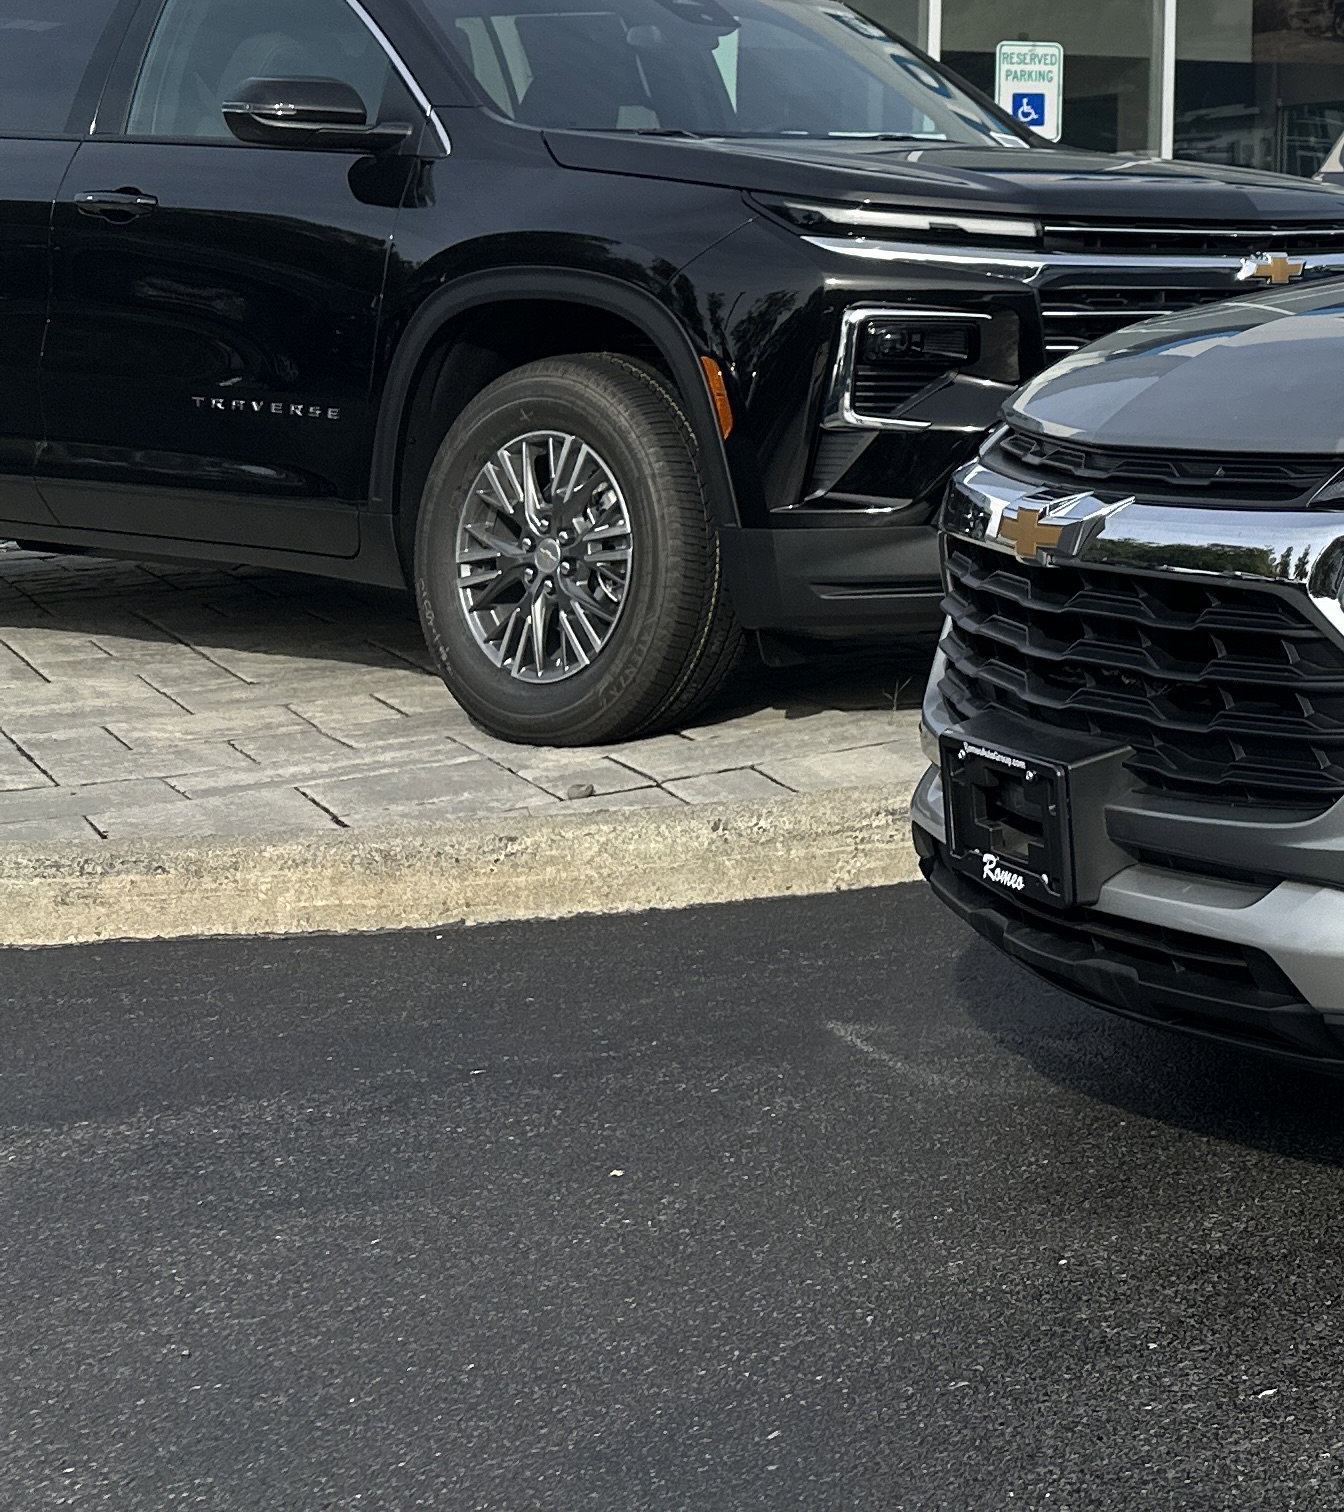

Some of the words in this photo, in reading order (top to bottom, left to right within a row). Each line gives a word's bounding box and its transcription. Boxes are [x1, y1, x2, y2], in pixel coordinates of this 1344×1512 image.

[1001, 52, 1058, 66] RESERVED
[1004, 69, 1054, 83] PARKING
[191, 396, 341, 419] TRAVERSE
[982, 853, 1025, 890] Romeo
